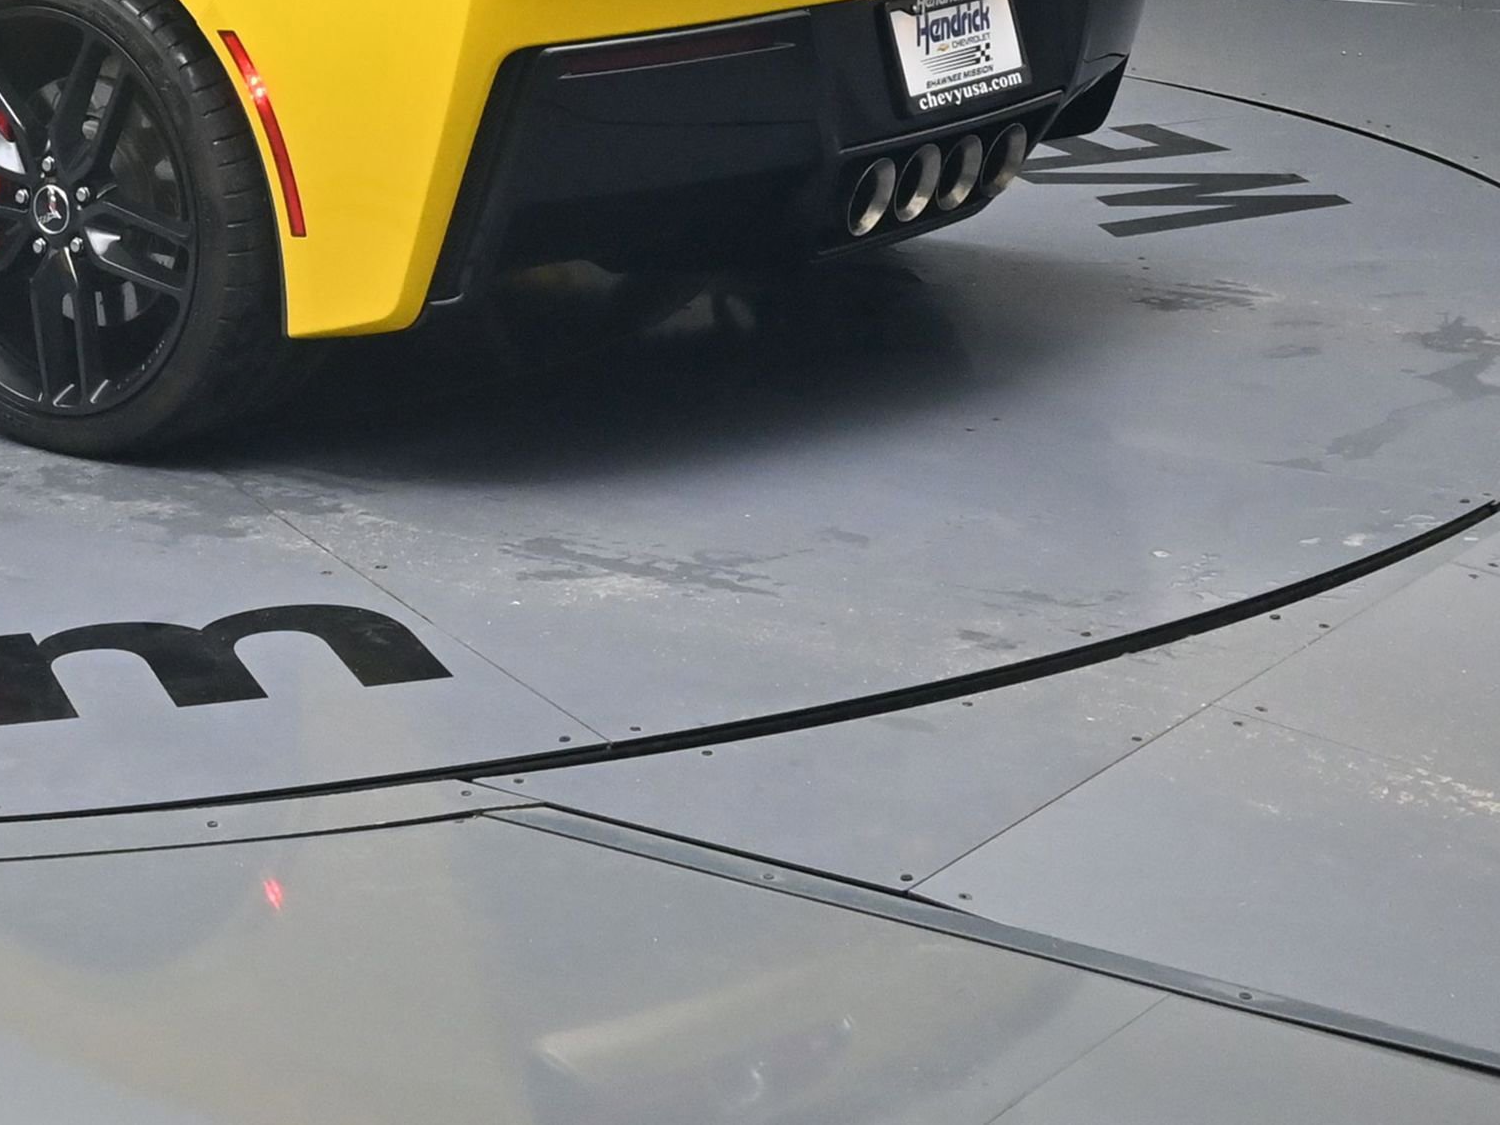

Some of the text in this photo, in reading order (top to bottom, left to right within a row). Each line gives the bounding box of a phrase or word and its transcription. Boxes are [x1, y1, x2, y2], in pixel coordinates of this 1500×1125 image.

[916, 0, 990, 55] Hendrick
[951, 32, 991, 49] CHEVROLET
[919, 72, 1023, 110] chevyusa.com
[926, 64, 994, 89] SHAWNEE MISSION
